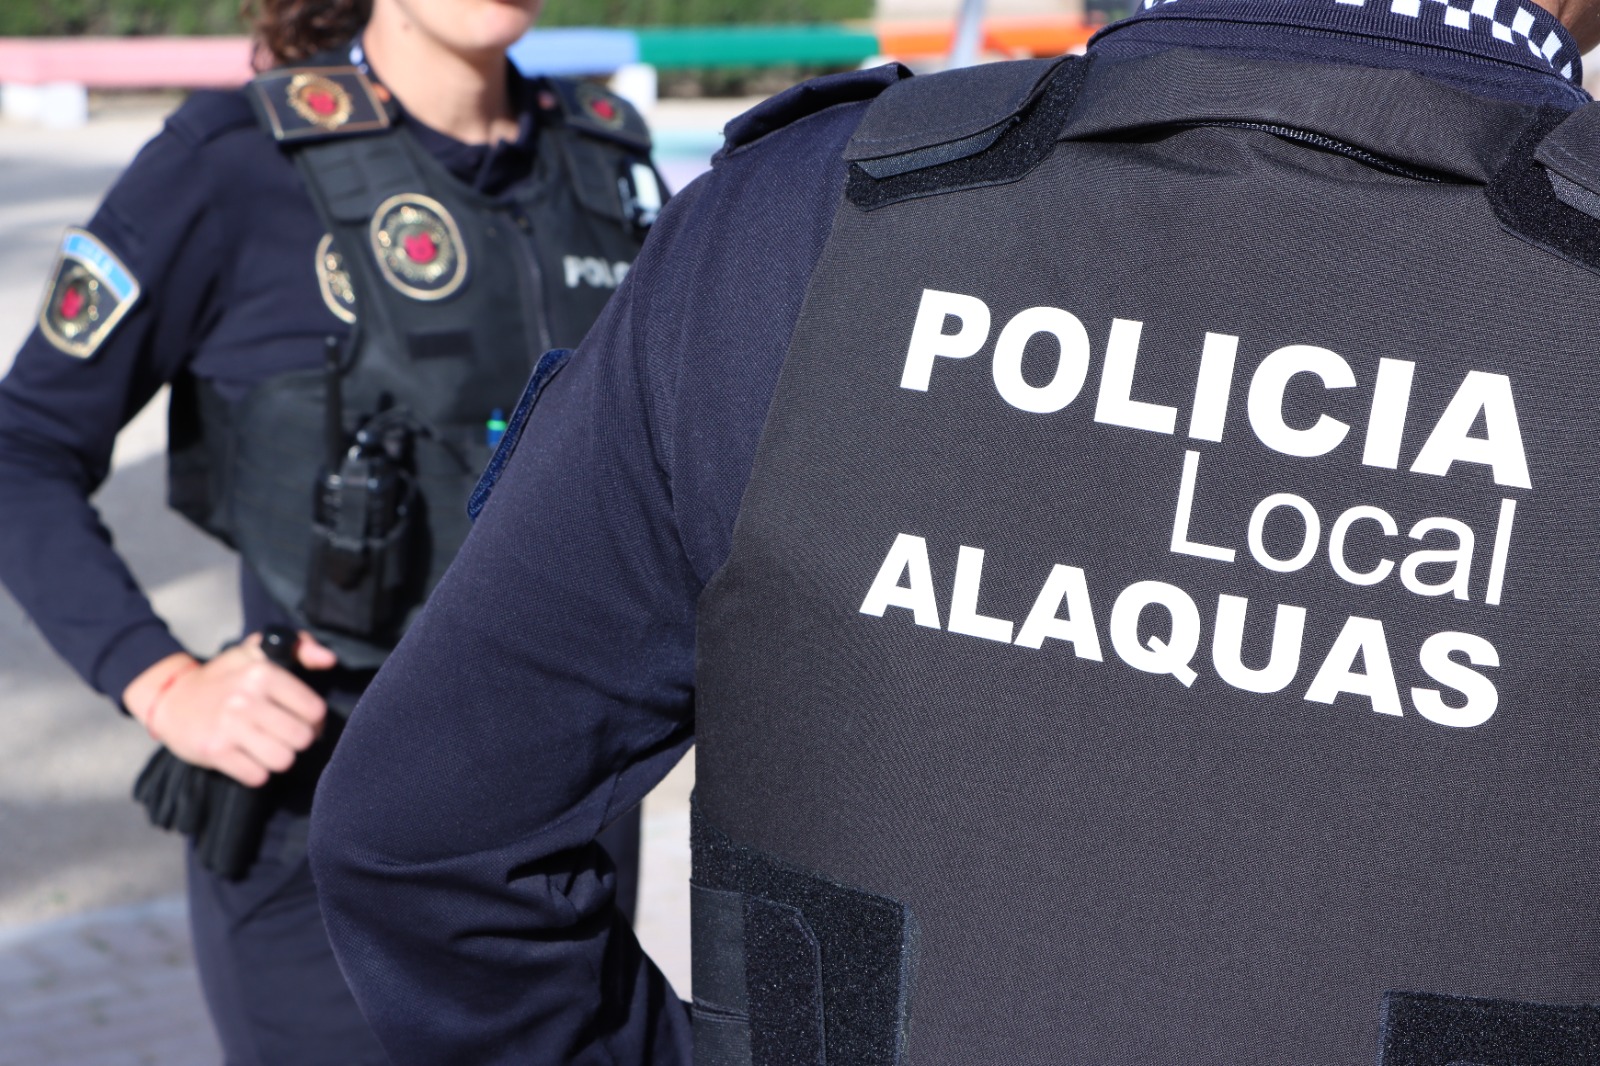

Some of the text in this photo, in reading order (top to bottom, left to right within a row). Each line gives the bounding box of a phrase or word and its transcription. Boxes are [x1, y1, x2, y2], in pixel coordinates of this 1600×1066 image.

[900, 289, 1532, 489] POLICIA
[1170, 450, 1516, 605] Local
[859, 533, 1500, 727] ALAQUAS
